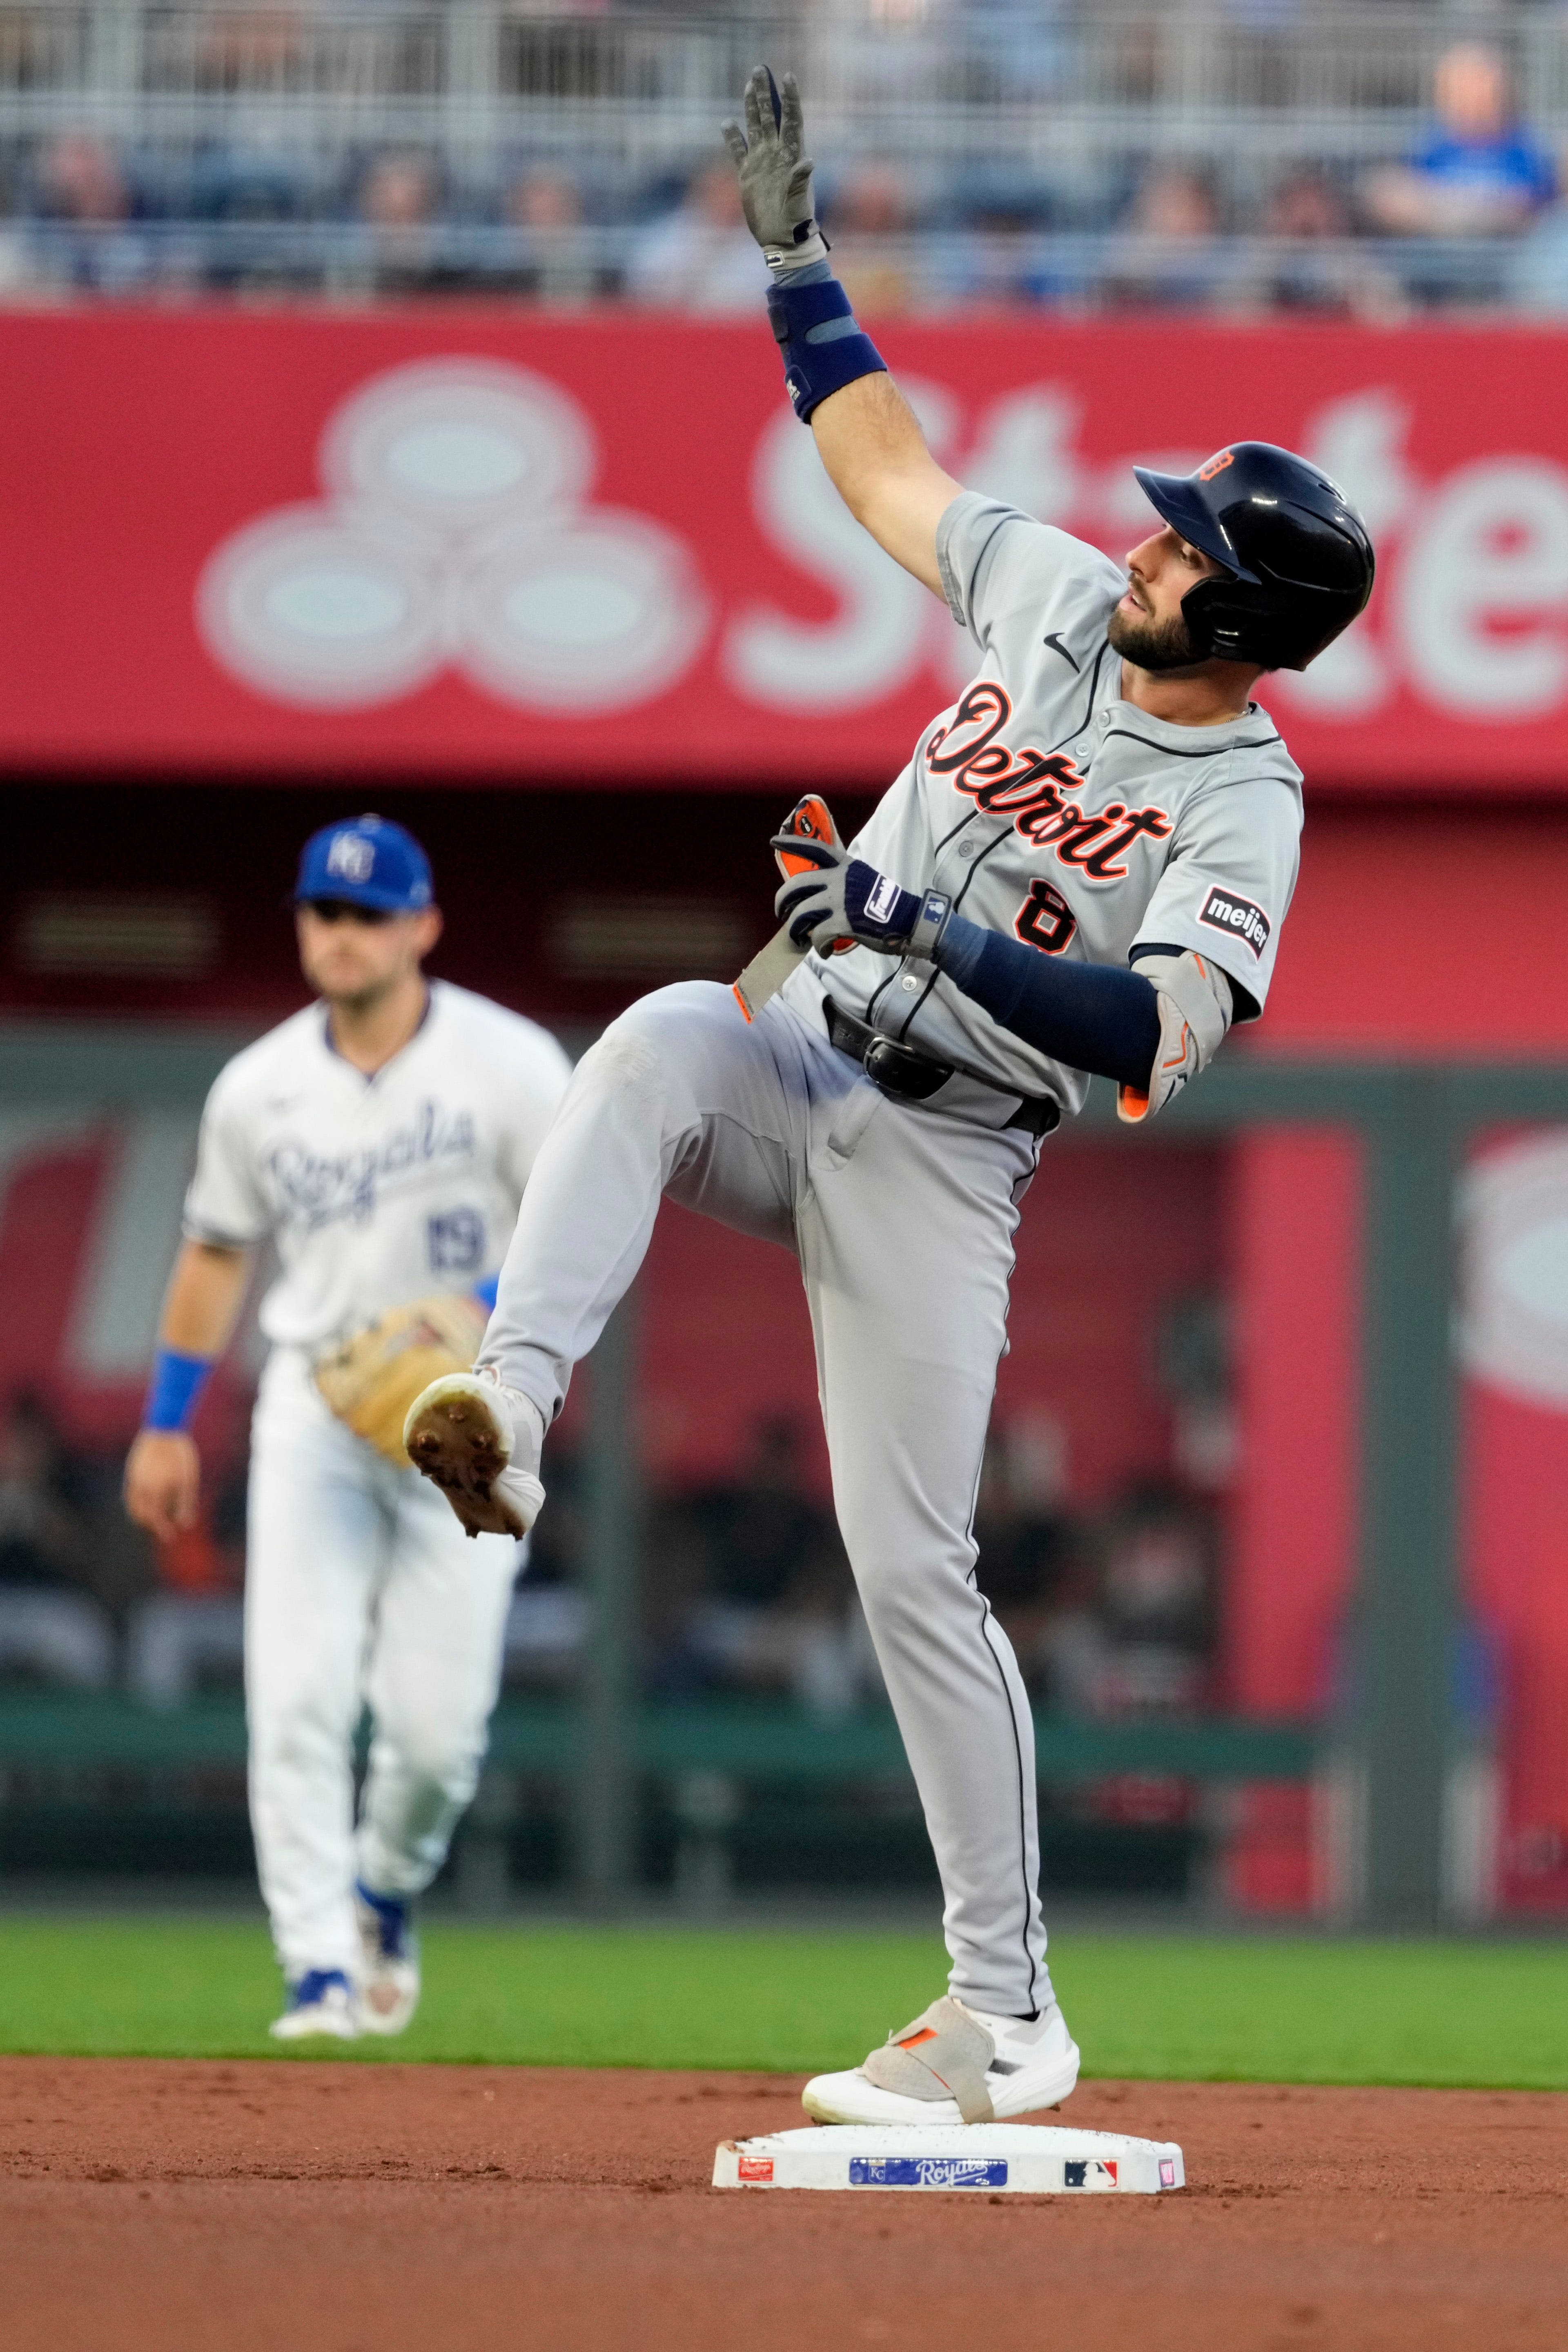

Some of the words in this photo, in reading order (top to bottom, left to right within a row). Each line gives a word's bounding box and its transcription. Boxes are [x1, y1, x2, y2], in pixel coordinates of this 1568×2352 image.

[925, 682, 1174, 882] Detroit
[1012, 878, 1078, 956] 8
[1207, 898, 1267, 948] meijer
[270, 1098, 476, 1231] Royals
[427, 1206, 485, 1272] 19
[871, 2167, 884, 2180] KC
[915, 2159, 988, 2185] Royals
